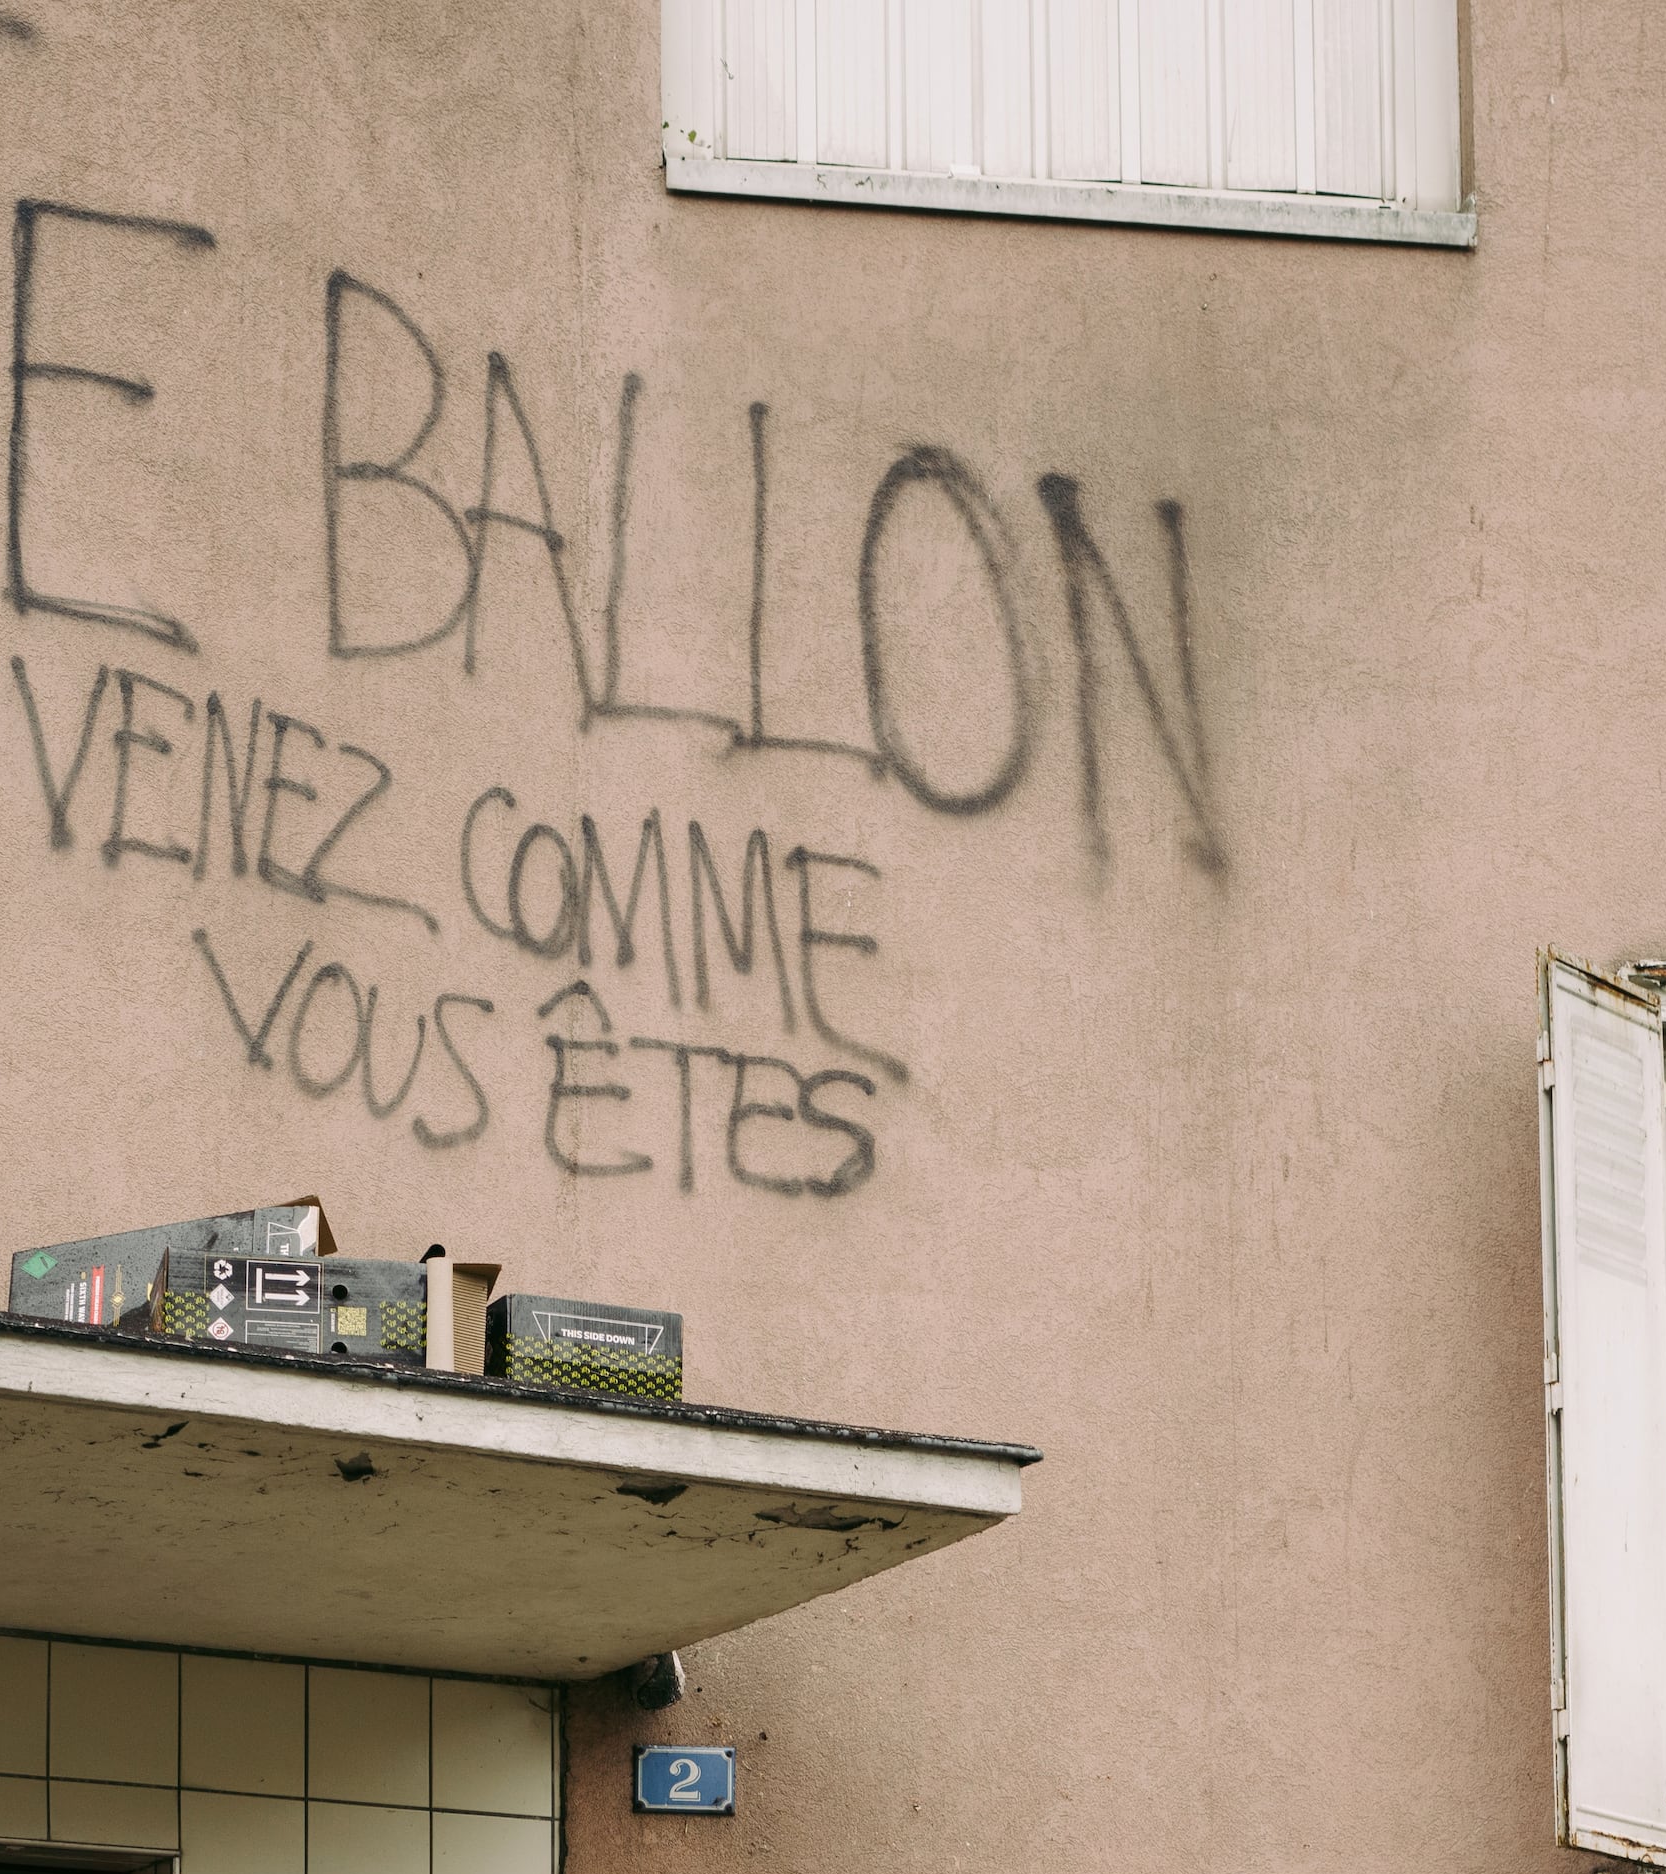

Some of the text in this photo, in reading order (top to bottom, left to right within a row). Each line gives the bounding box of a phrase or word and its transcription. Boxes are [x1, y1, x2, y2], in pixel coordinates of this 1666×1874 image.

[322, 267, 1230, 895] BALLON
[8, 655, 909, 1075] VENEZ COMME
[192, 926, 878, 1198] VOUS ÊTES
[560, 1328, 635, 1346] THIS SIDE DOWN
[669, 1758, 703, 1802] 2
